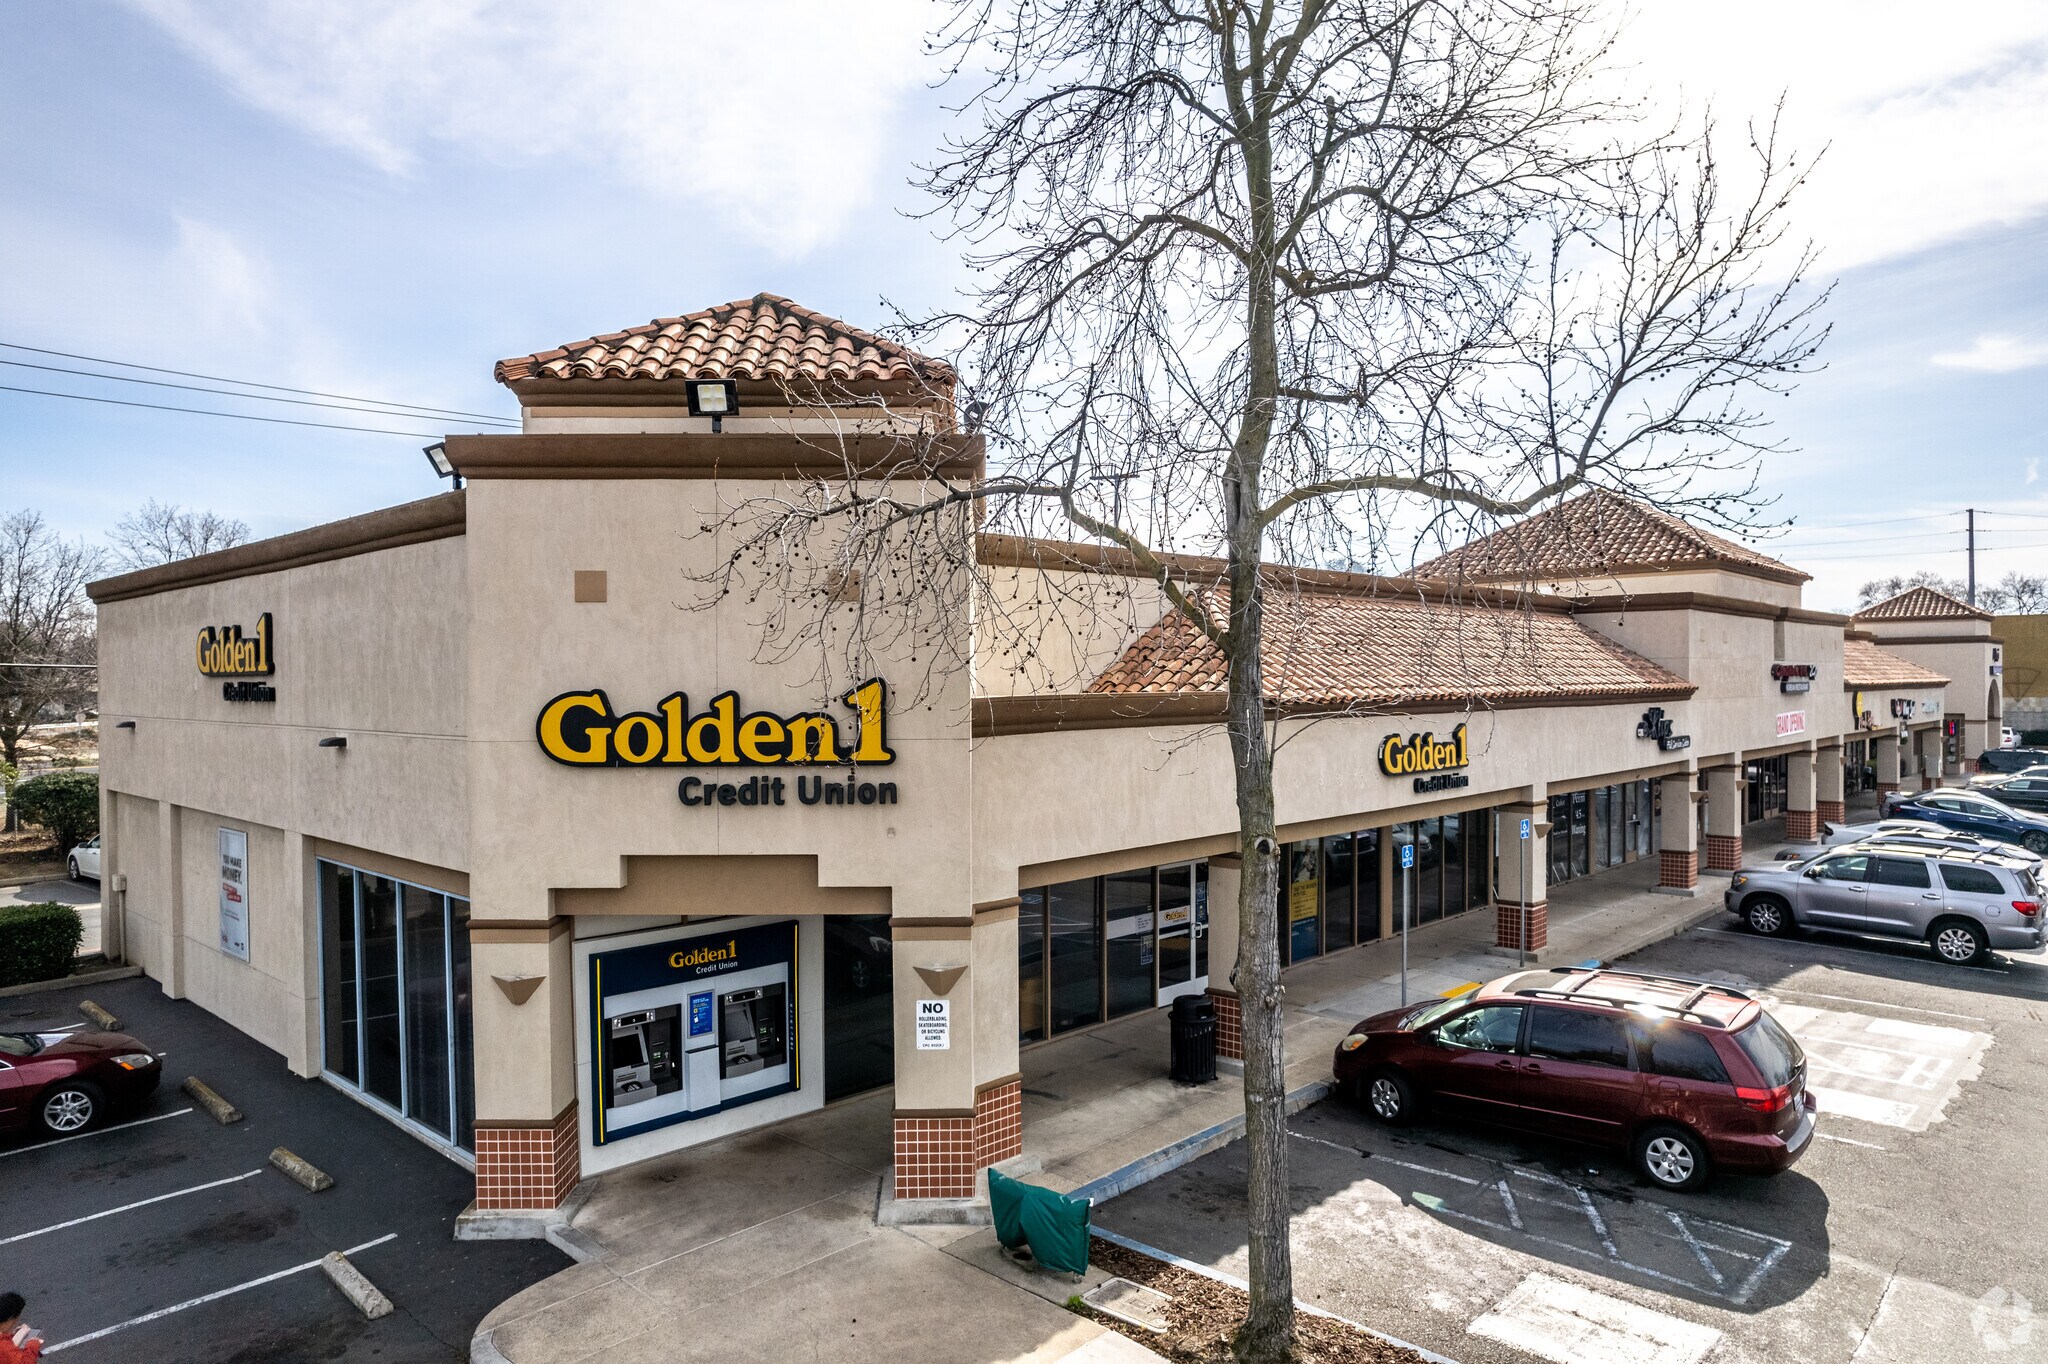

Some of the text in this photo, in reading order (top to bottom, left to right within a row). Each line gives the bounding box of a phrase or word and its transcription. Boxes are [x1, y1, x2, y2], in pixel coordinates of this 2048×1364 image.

[247, 682, 275, 702] Union
[1777, 712, 1804, 735] GRAND OPENING
[678, 775, 898, 806] Credit Union
[1414, 773, 1469, 793] Credit Union
[230, 856, 242, 868] MAKE
[222, 865, 243, 885] MONEY.
[696, 961, 738, 974] Credit Union
[922, 1003, 944, 1014] NO
